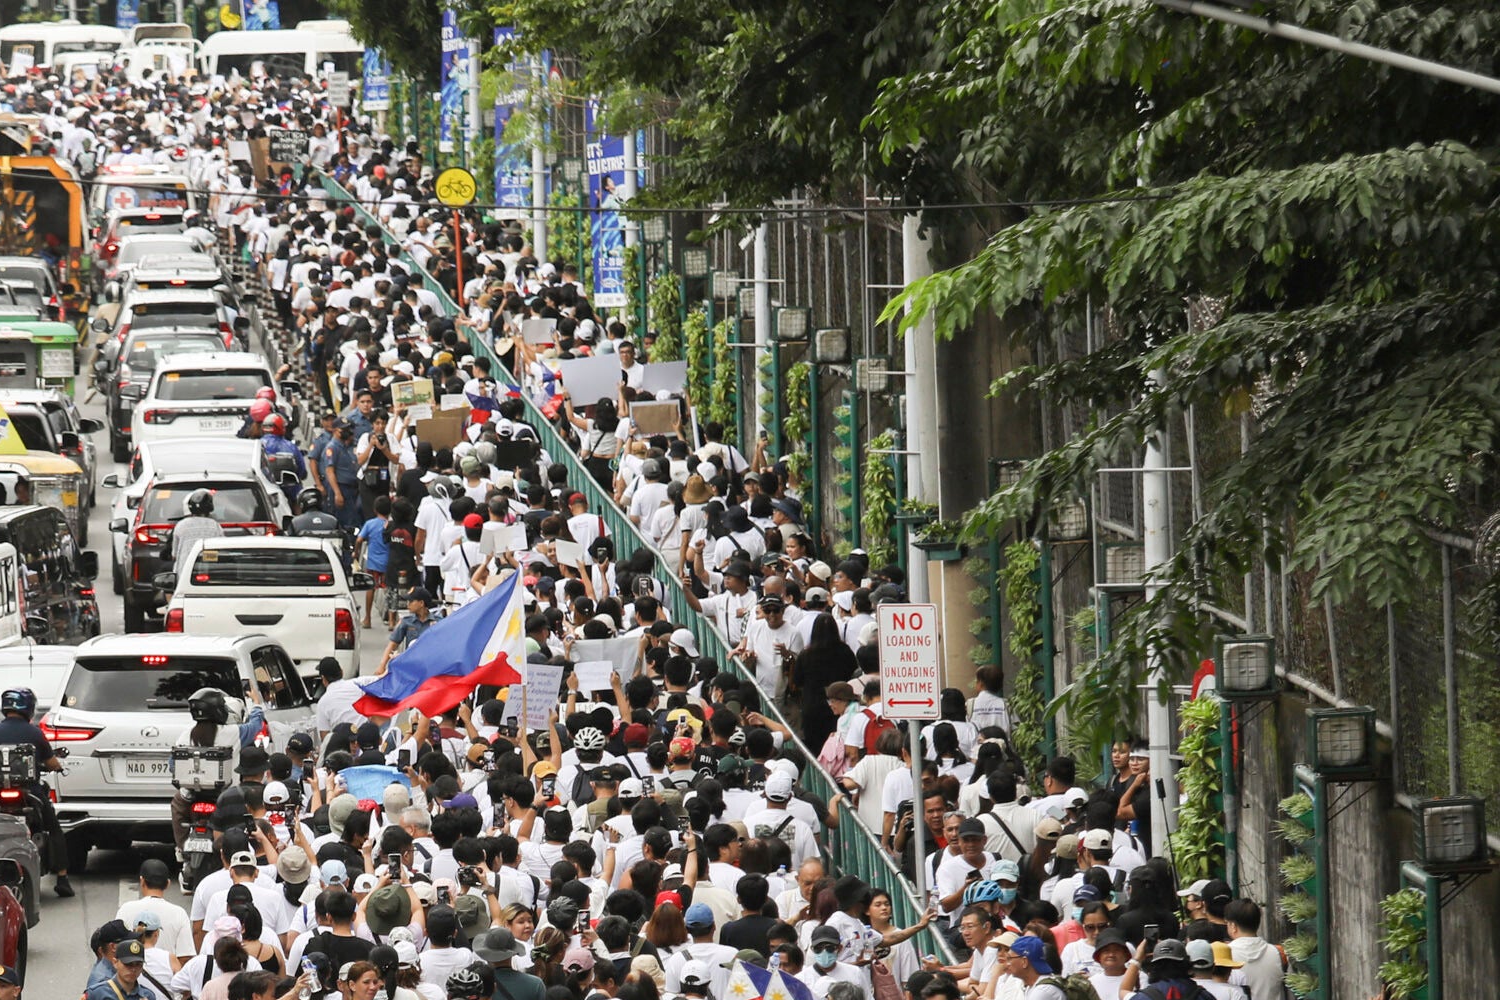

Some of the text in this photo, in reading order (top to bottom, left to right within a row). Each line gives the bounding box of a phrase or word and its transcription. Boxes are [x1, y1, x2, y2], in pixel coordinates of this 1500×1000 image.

[893, 612, 923, 631] NO
[886, 635, 931, 647] LOADING
[900, 651, 918, 662] AND
[885, 667, 935, 678] UNLOADING
[888, 682, 933, 693] ANYTIME
[151, 764, 169, 773] 997
